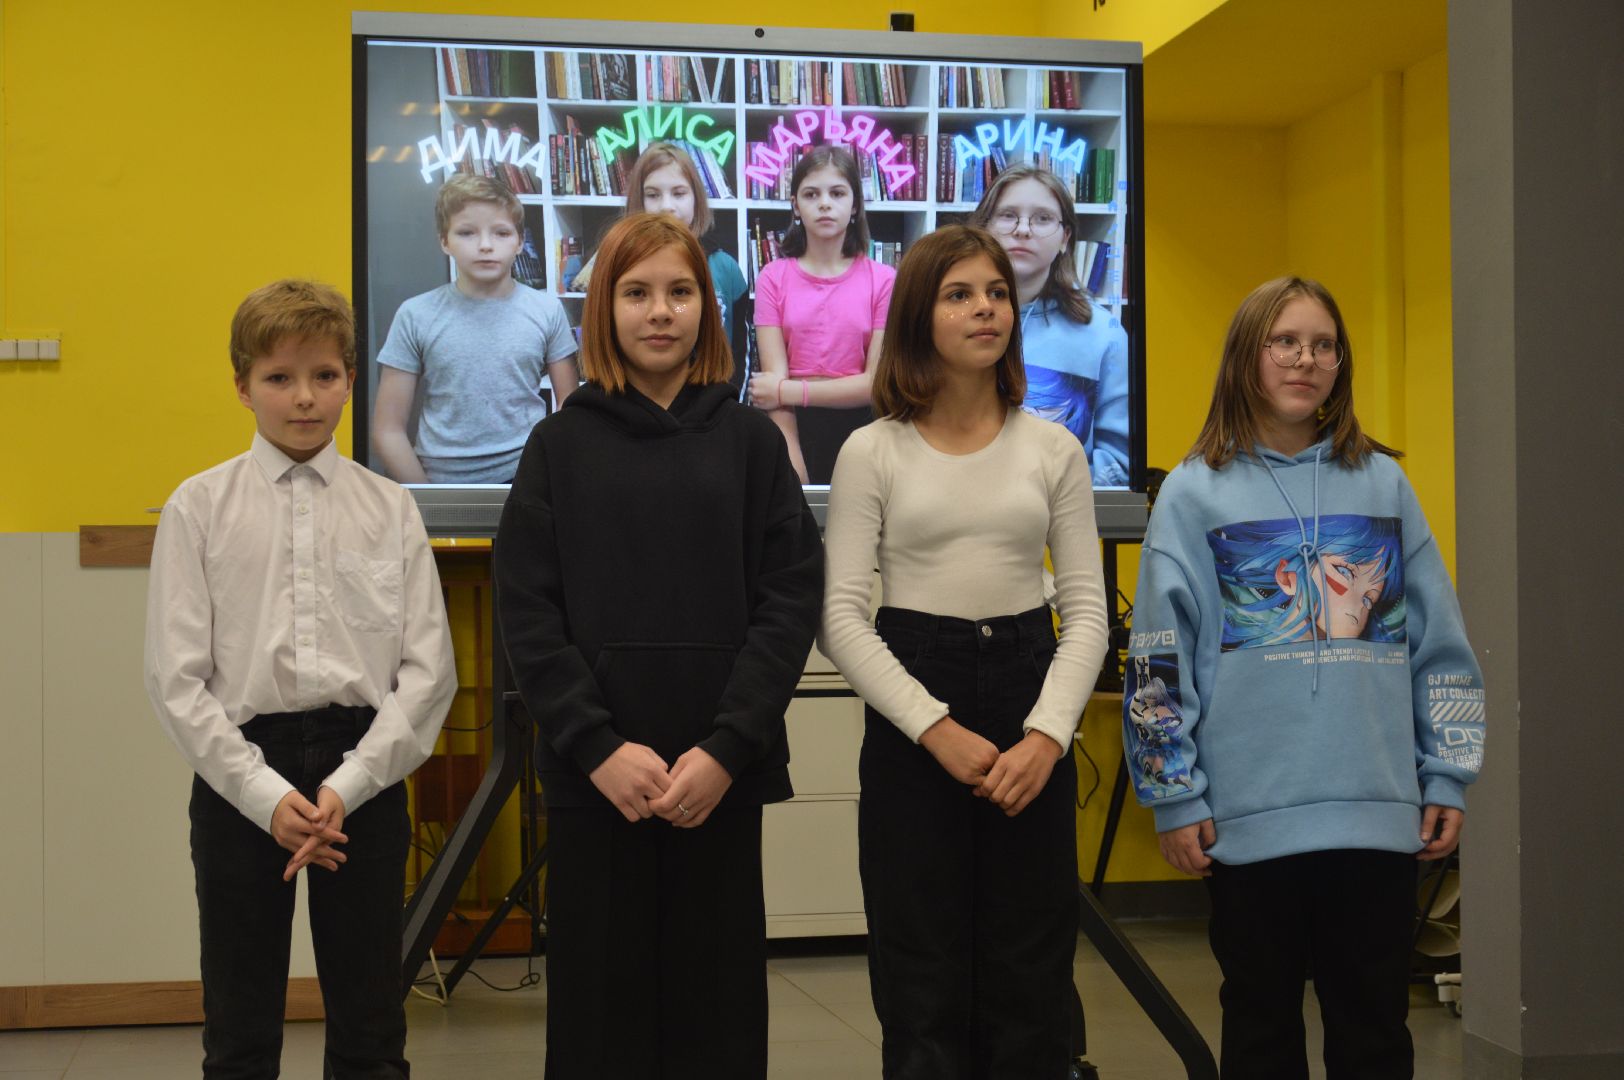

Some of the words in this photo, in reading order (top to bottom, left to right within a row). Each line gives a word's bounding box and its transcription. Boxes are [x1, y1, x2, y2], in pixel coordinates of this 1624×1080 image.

[597, 106, 735, 166] АЛИСА
[745, 107, 917, 193] МАРЬЯНА
[952, 118, 1088, 174] АРИНА
[417, 127, 546, 183] ДИМА
[1292, 651, 1318, 659] THINKIN
[1320, 649, 1332, 657] AND
[1429, 688, 1448, 700] ART
[1444, 675, 1472, 686] ANIME
[1438, 746, 1469, 759] POSITIVE
